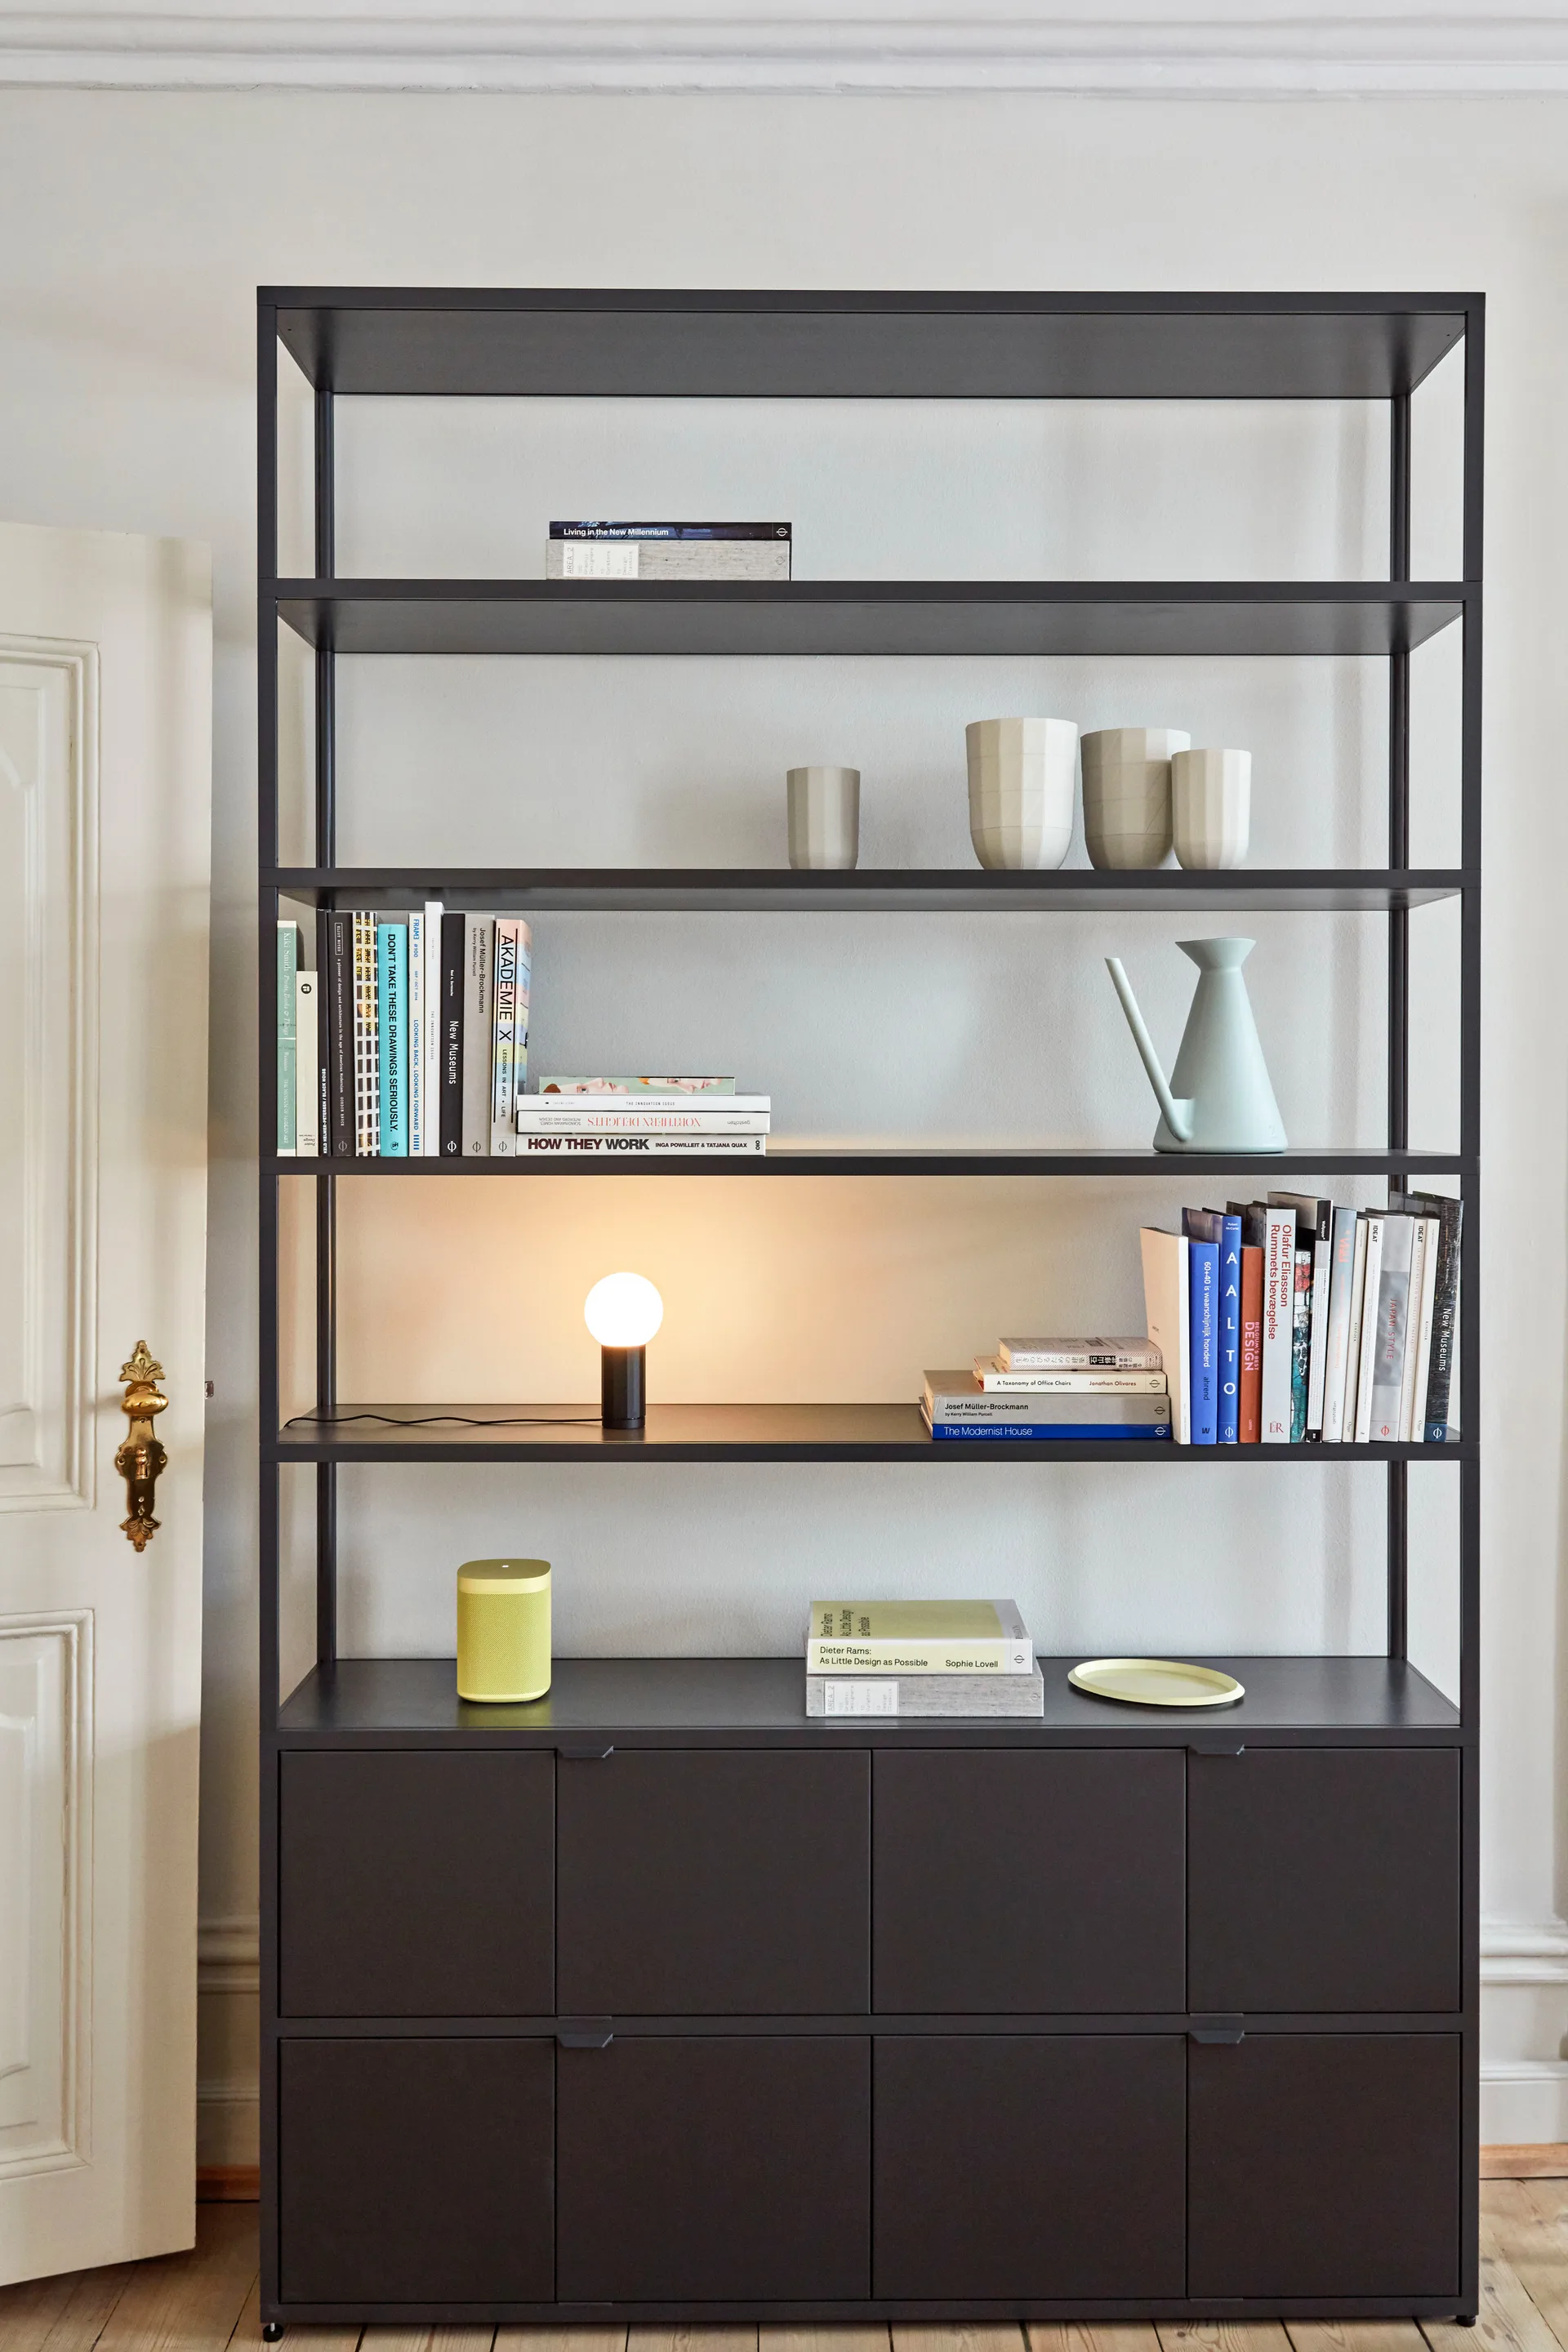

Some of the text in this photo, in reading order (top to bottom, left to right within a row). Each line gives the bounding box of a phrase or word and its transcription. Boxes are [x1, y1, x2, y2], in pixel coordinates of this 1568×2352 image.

[564, 528, 586, 537] Living
[499, 934, 514, 1042] AKADEMIE X
[388, 933, 398, 1133] DON'T TAKE THESE DRAWINGS SERIOUSLY.
[448, 1021, 459, 1085] New Museums
[528, 1138, 650, 1150] HOW THEY WORK
[587, 1117, 640, 1127] DELIGHTS
[1267, 1224, 1280, 1340] Rummets bevægelse
[1280, 1225, 1292, 1307] Olafur Eliasson
[1202, 1293, 1211, 1337] waarschijnlijk
[1387, 1298, 1397, 1360] JAPAN STYLE
[1245, 1321, 1255, 1371] DESIGN
[1438, 1308, 1453, 1371] New Museums
[944, 1427, 1033, 1436] The Modernist House
[831, 1657, 853, 1665] Little
[854, 1657, 882, 1667] Design
[894, 1659, 928, 1667] Possible
[847, 1646, 871, 1655] Rams:
[945, 1659, 973, 1668] Sophie
